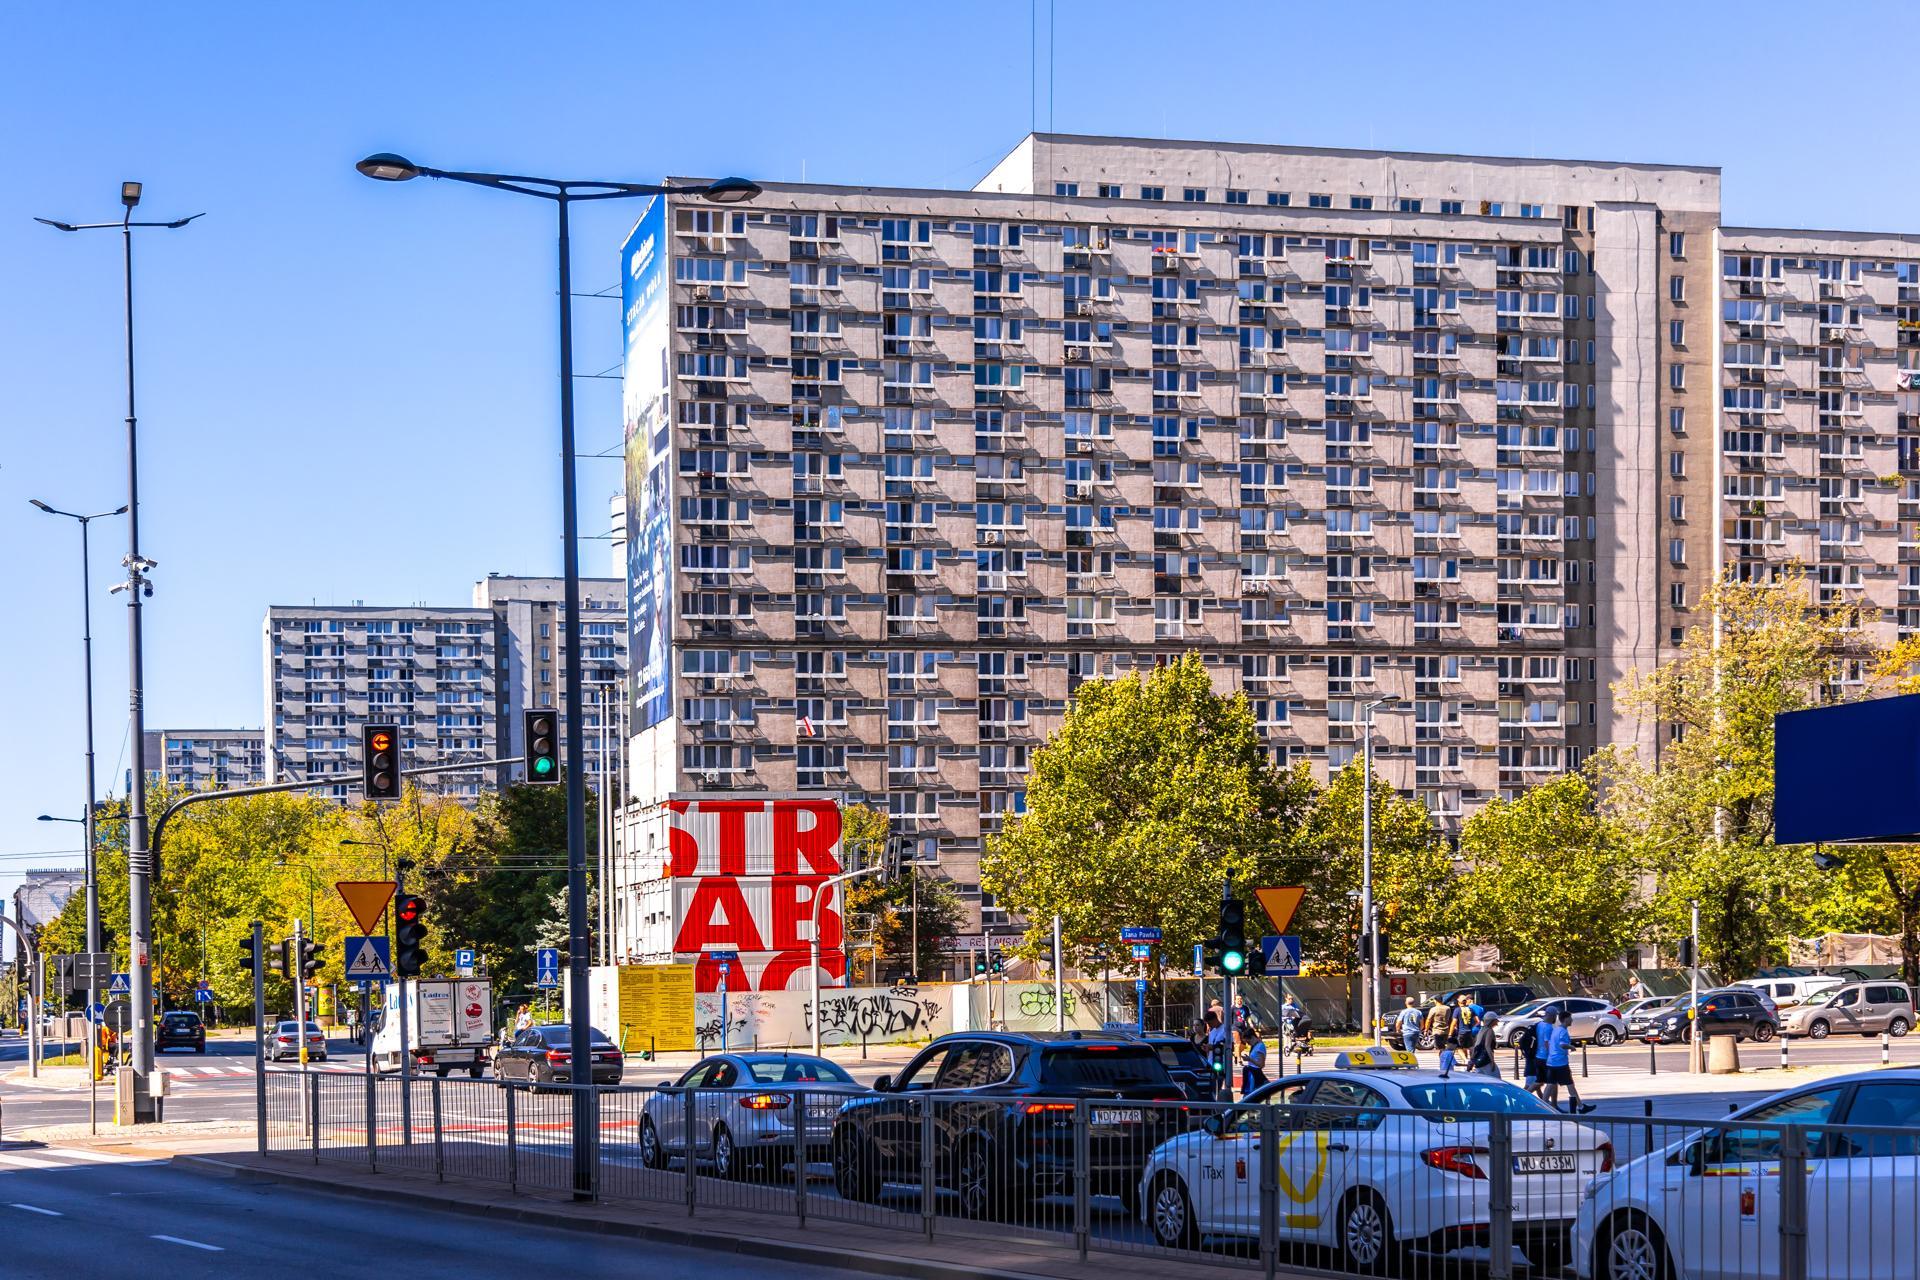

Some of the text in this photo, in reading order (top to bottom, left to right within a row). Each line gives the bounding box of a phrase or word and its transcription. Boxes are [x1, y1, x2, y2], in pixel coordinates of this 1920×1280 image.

[662, 800, 844, 876] STR
[673, 876, 844, 951] AB
[460, 952, 470, 965] P
